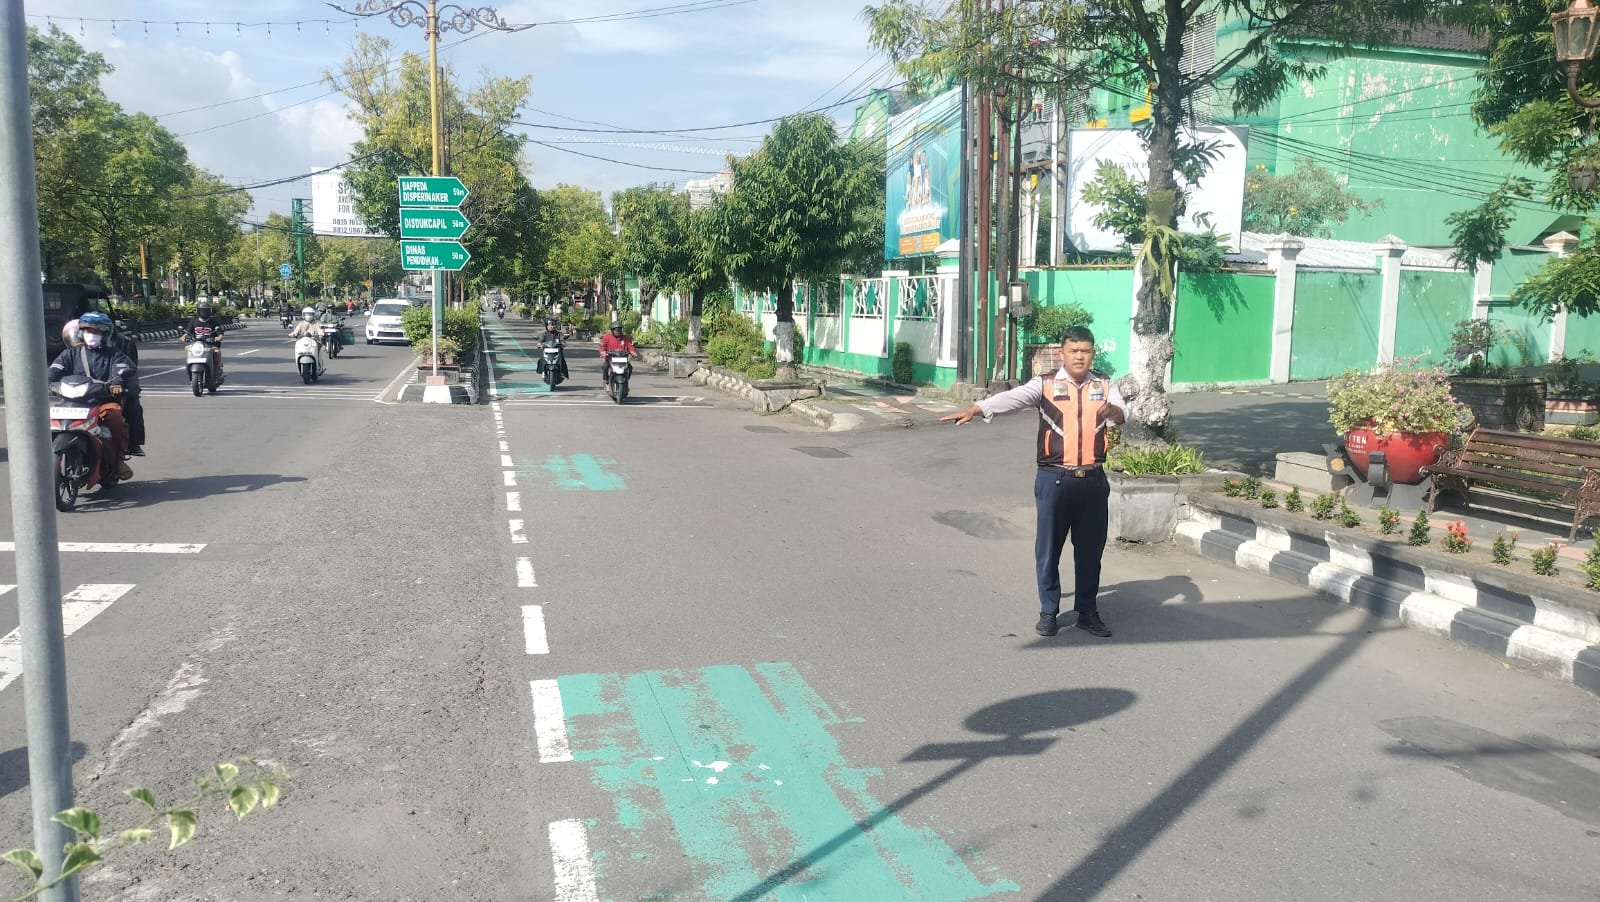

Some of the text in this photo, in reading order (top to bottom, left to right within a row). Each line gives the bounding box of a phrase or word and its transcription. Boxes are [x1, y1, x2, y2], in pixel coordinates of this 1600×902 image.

[402, 181, 428, 191] BAPPEDA
[403, 192, 449, 202] DISPERINAKER
[404, 217, 447, 229] DISDUKCAPIL
[405, 244, 426, 254] DINAS
[406, 256, 439, 266] PENDIDIKAN
